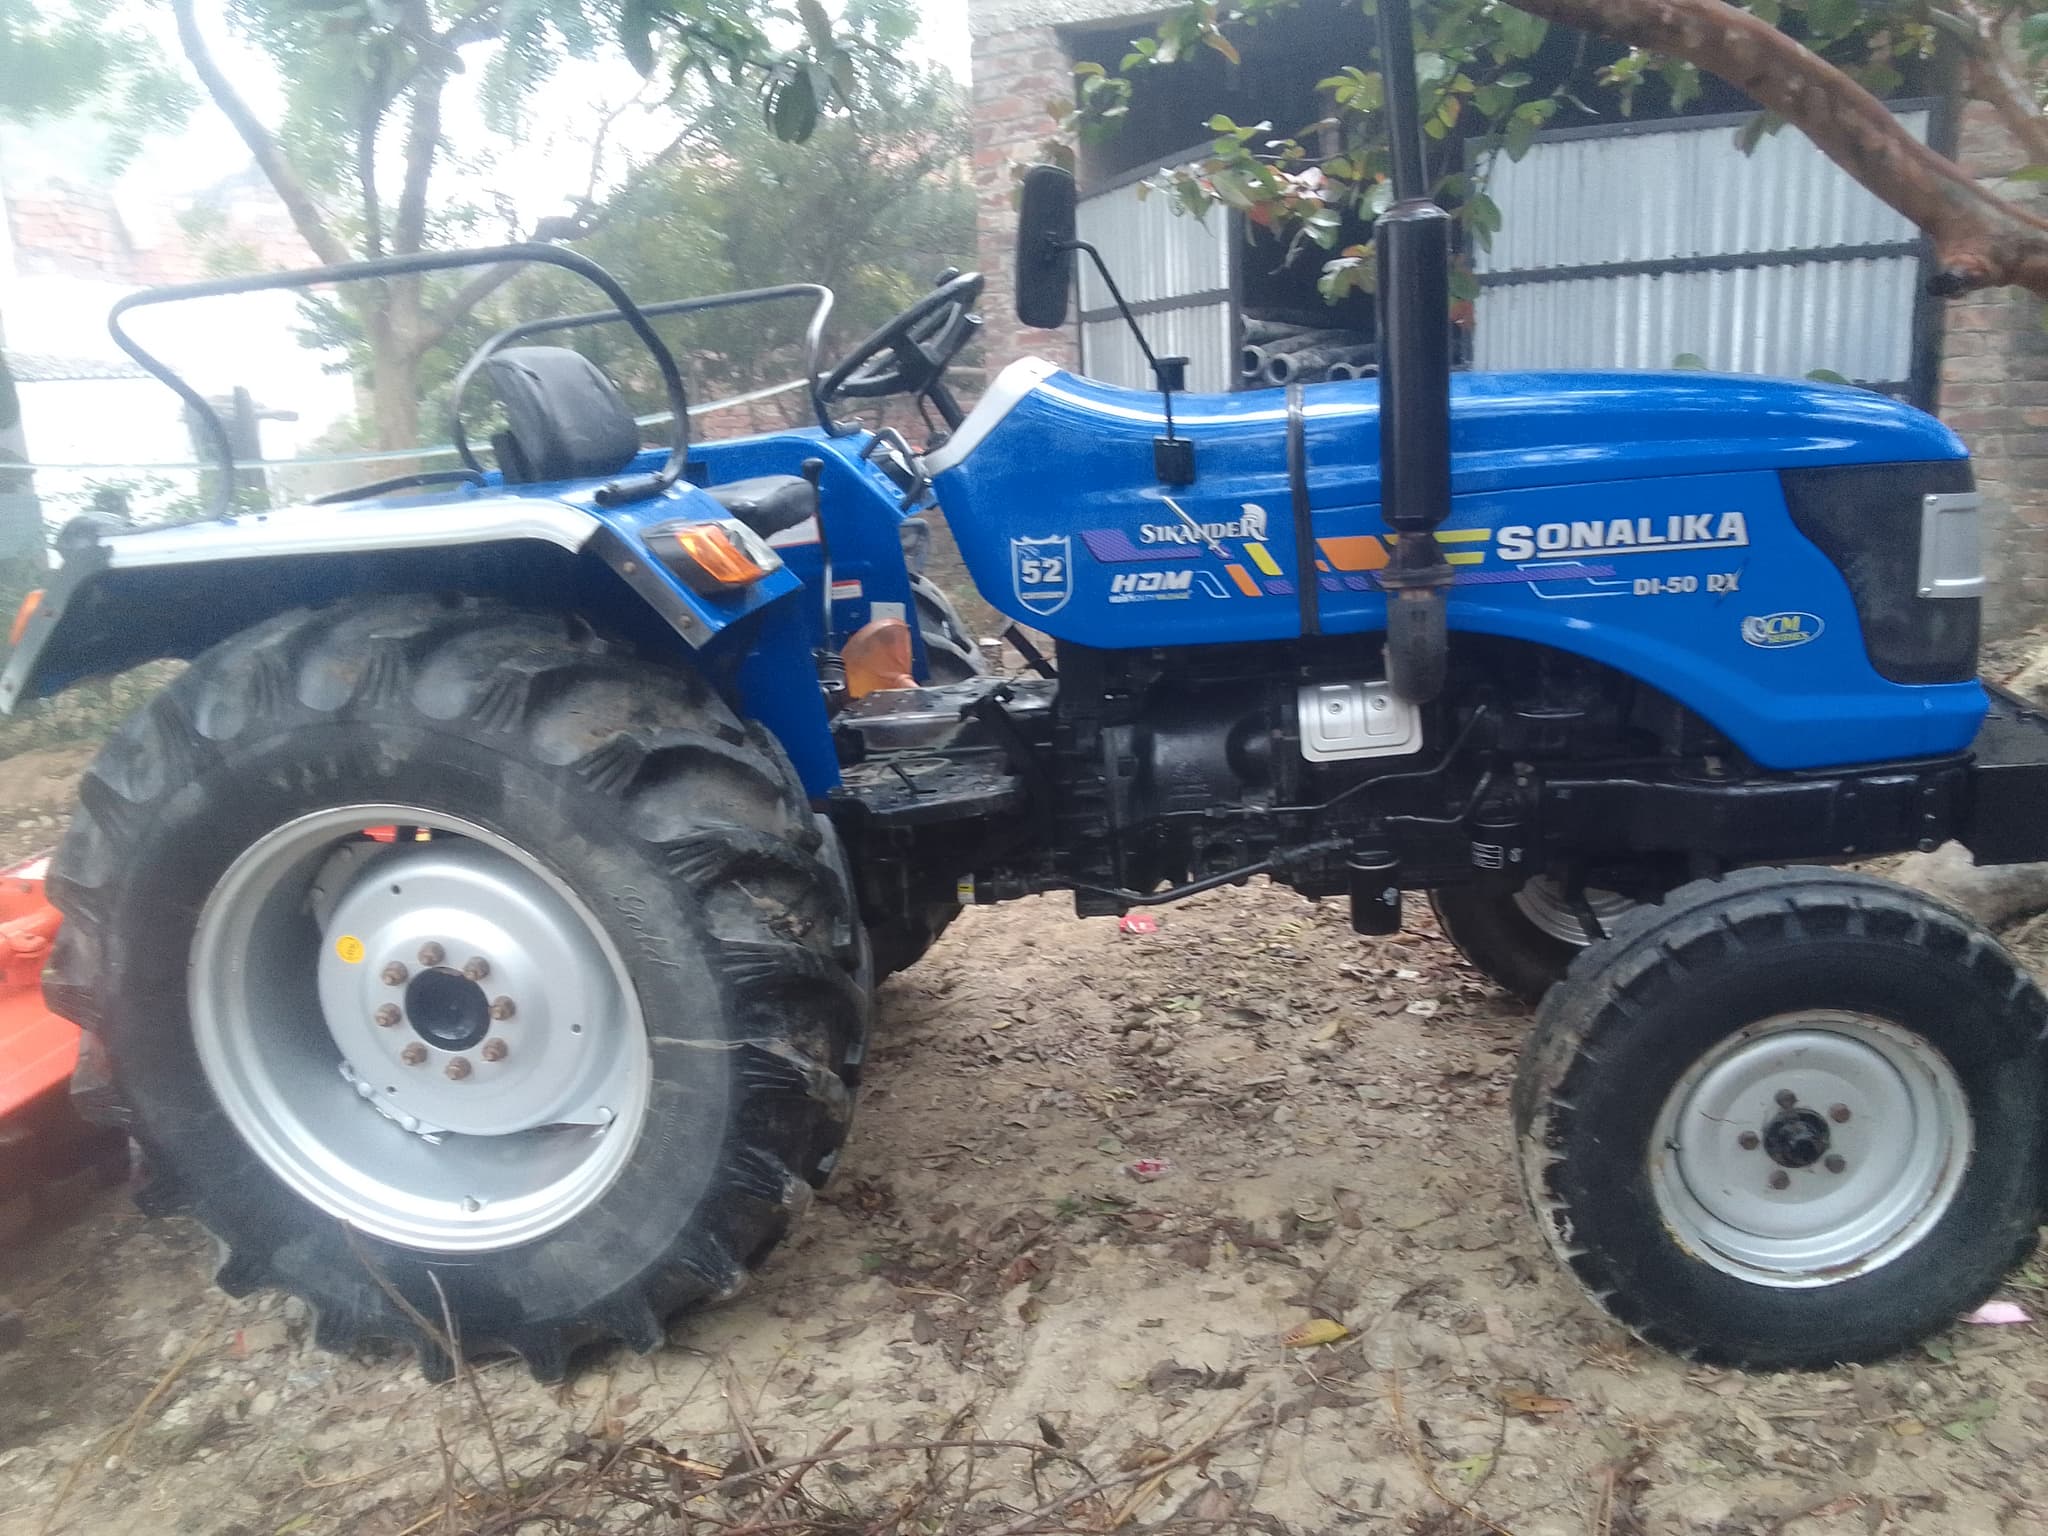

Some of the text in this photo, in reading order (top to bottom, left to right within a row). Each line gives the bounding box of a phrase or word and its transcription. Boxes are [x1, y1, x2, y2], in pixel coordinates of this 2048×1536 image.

[1496, 512, 1749, 560] SONALIKA
[1021, 559, 1064, 584] 52
[1110, 570, 1194, 593] HDM
[1633, 576, 1698, 596] DI-50
